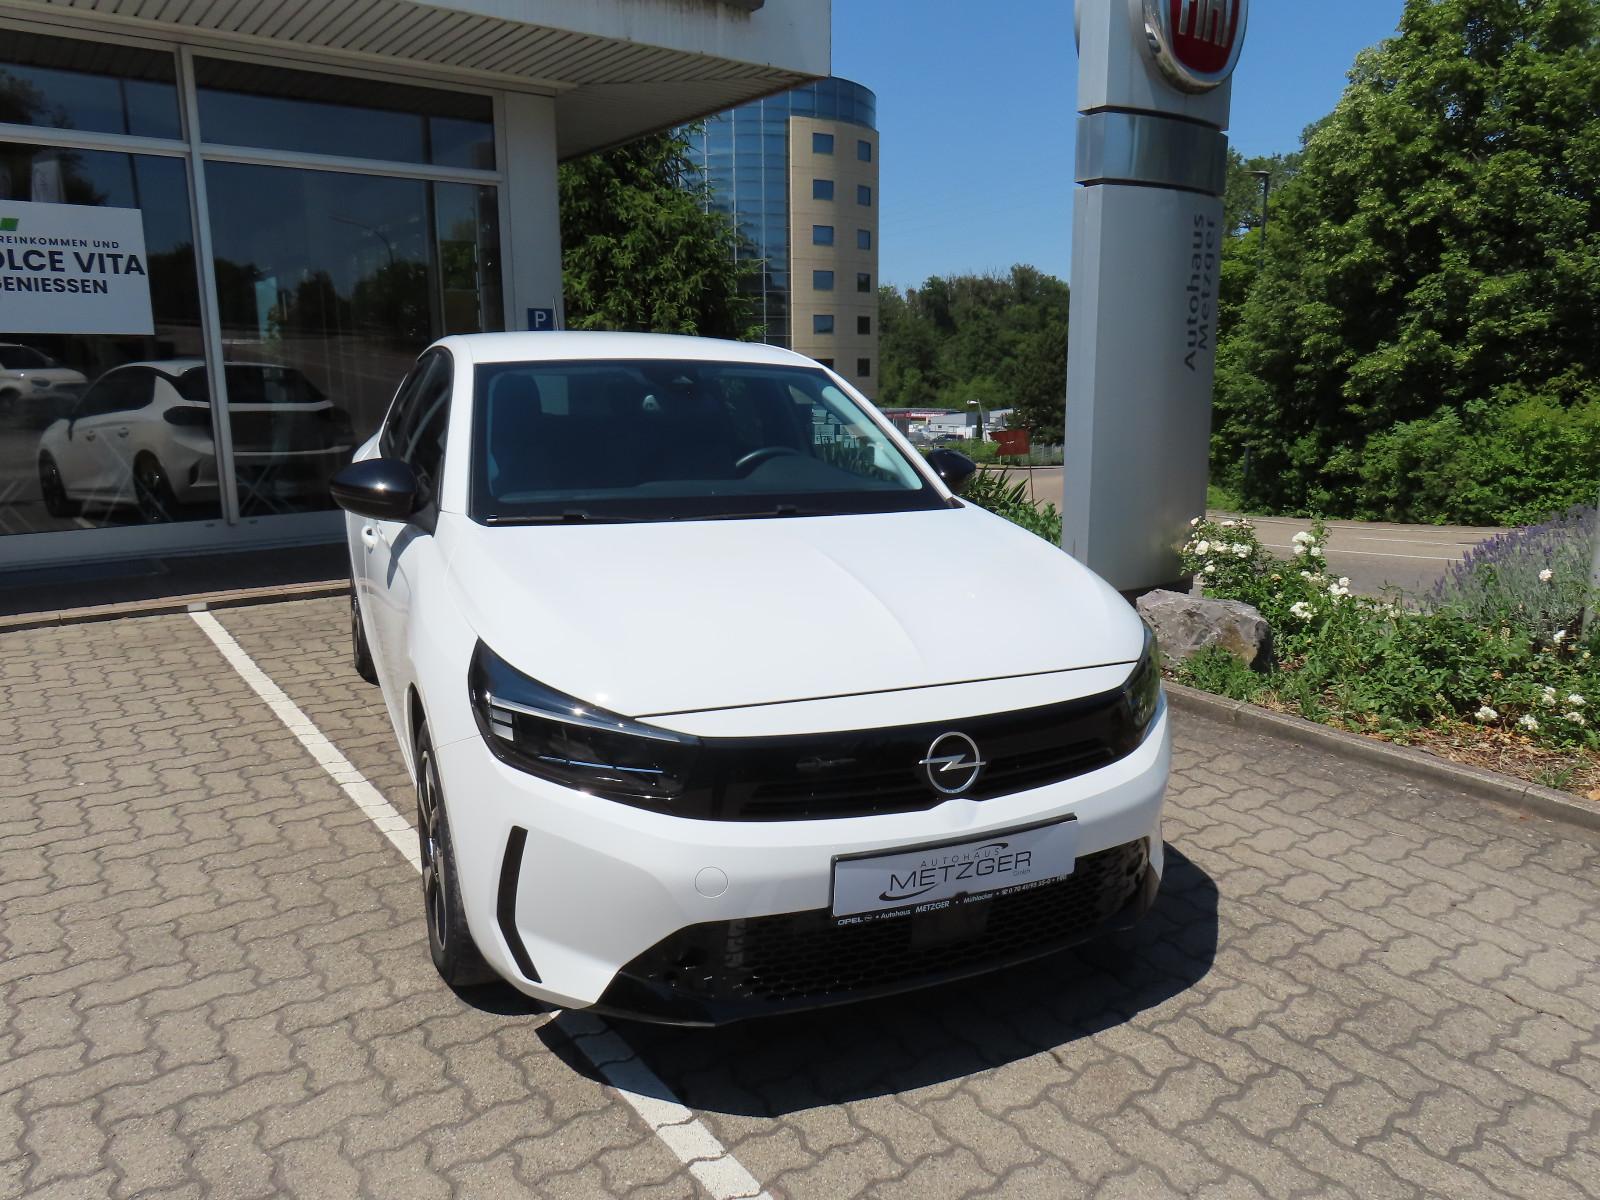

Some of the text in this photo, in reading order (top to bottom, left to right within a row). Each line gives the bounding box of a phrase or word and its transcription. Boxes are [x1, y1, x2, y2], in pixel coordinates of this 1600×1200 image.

[93, 240, 119, 249] UND
[0, 249, 146, 275] LCE VITA
[0, 276, 108, 294] ENIESSEN
[1184, 214, 1205, 372] Autohaus
[1198, 216, 1215, 350] Metzger
[535, 310, 547, 328] P
[889, 850, 1032, 892] METZGER
[920, 848, 1000, 868] AUTOHAUS
[837, 916, 864, 926] OPEL
[880, 909, 911, 920] Autohaus
[915, 900, 950, 914] METZGER
